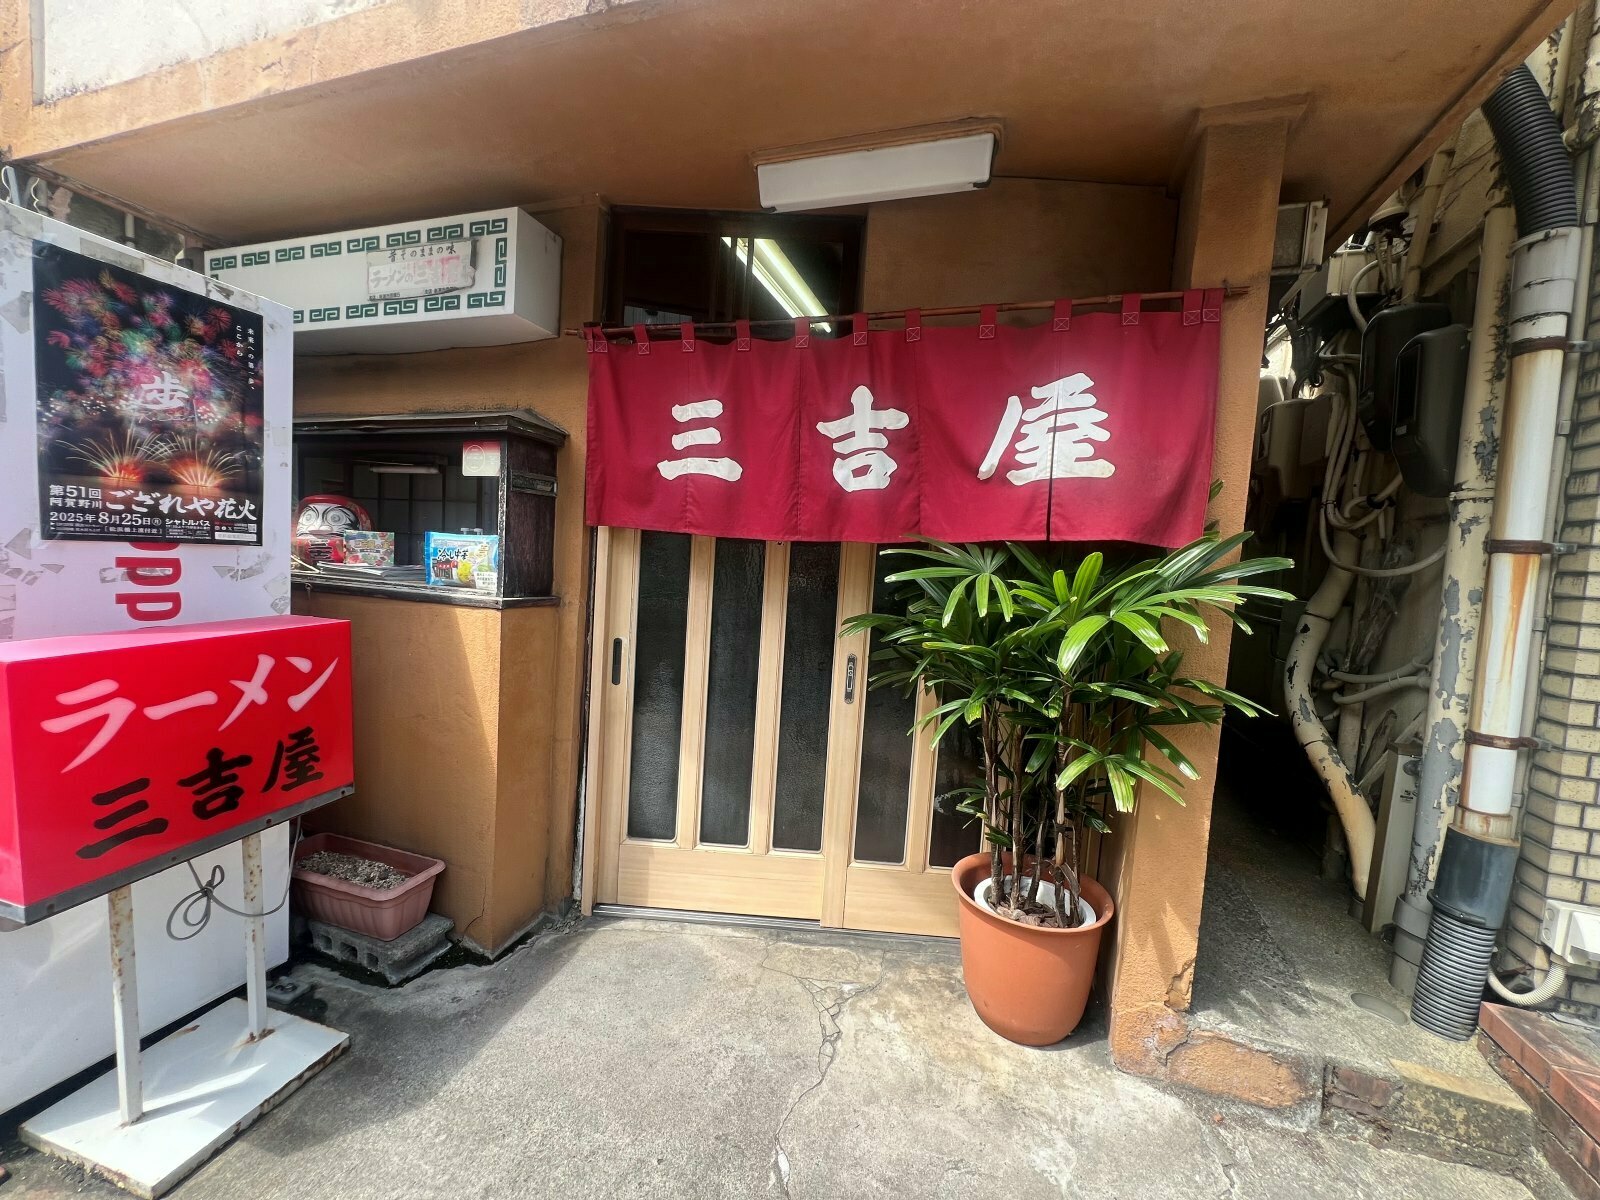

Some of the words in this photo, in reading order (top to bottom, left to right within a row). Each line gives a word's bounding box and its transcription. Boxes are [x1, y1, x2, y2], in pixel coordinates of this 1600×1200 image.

[235, 325, 244, 357] ここから
[139, 370, 190, 410] 歩
[657, 371, 1116, 493] 三吉屋
[48, 484, 102, 499] 第51回
[48, 497, 103, 510] 阿賀野川
[105, 489, 258, 520] ござれや花火
[165, 518, 211, 527] シャトルバス
[40, 653, 340, 774] ラーメン
[75, 726, 324, 860] 三吉屋
